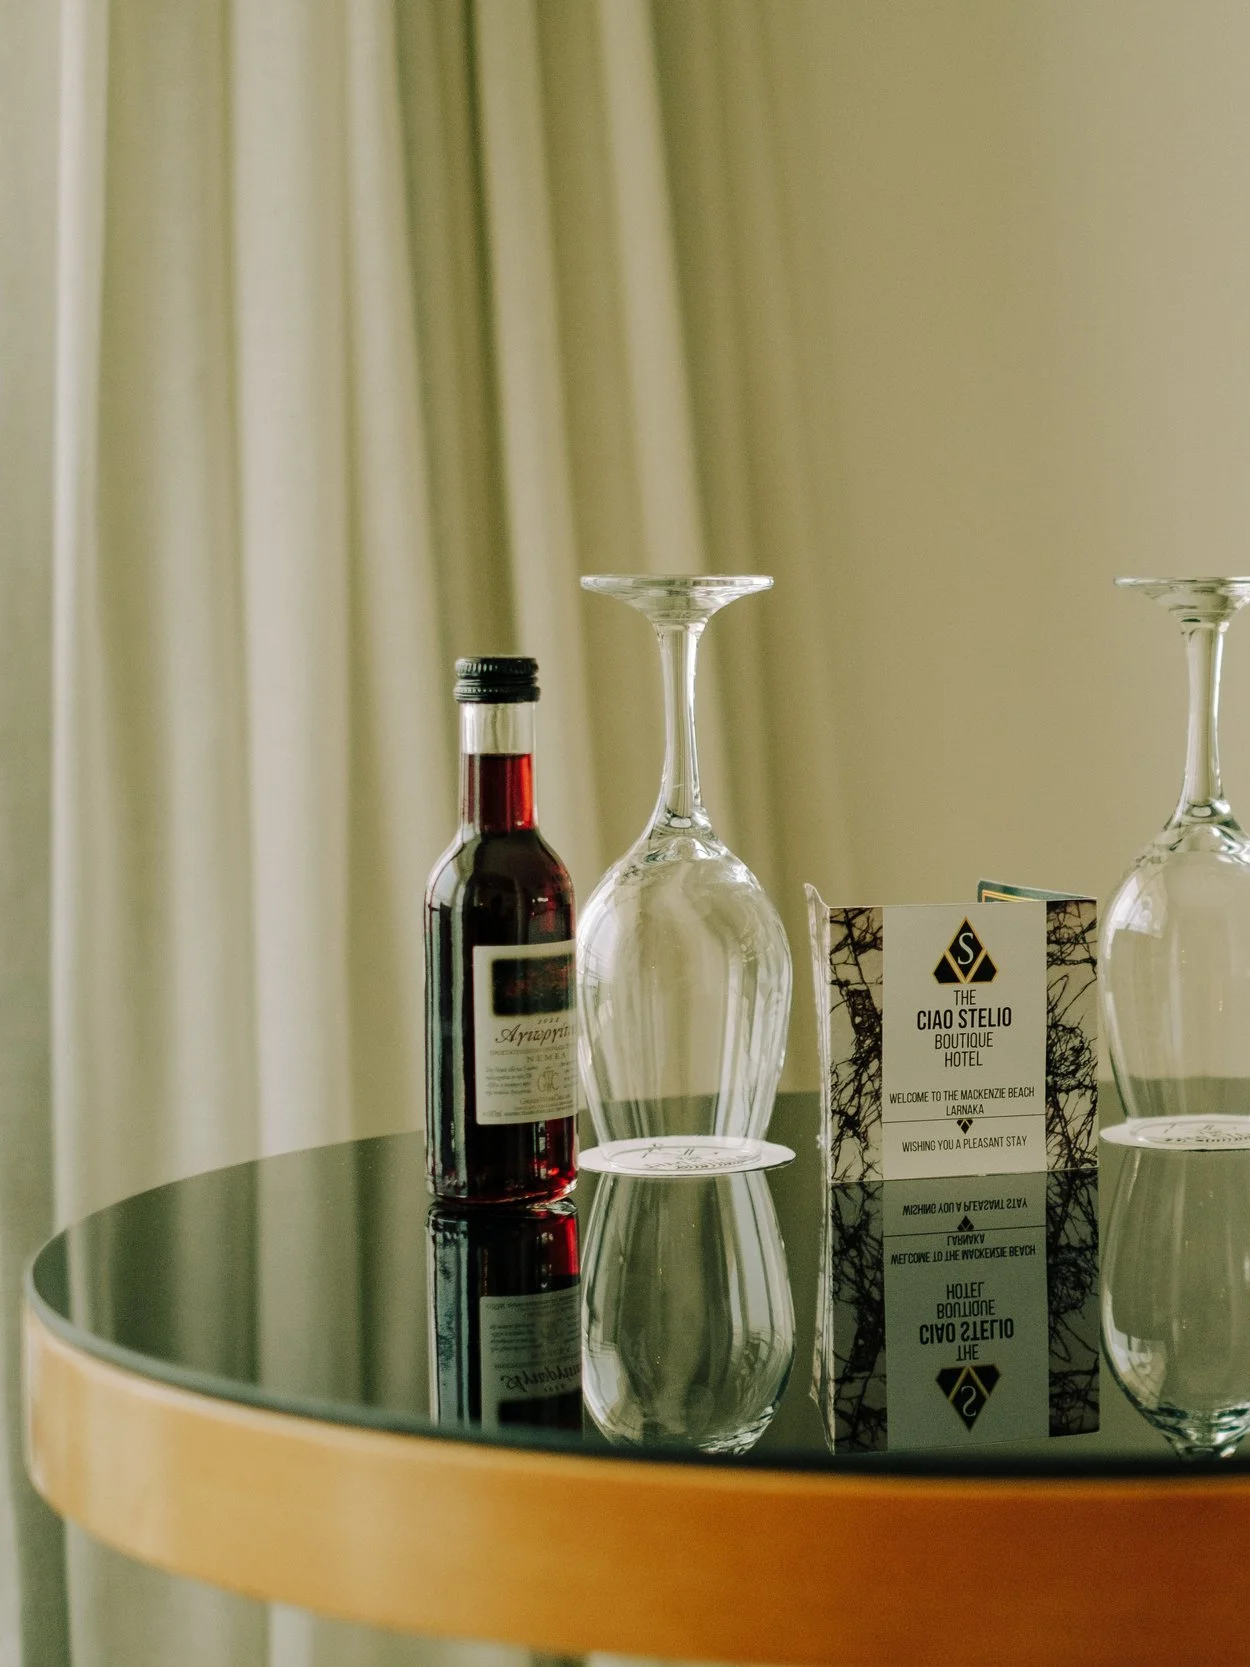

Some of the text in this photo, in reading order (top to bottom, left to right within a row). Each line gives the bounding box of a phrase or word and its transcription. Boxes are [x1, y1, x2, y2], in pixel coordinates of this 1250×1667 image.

[957, 932, 974, 966] S
[953, 989, 977, 1006] THE
[917, 1006, 1012, 1031] CIAO STELIO
[934, 1031, 994, 1050] BOUTIQUE
[944, 1050, 984, 1068] HOTEL
[889, 1086, 1035, 1105] WELCOME TO THE MACKENZIE BEACH
[946, 1103, 985, 1116] LARNAKA
[902, 1135, 1028, 1153] WISHING YOU A PLEASANT STAY
